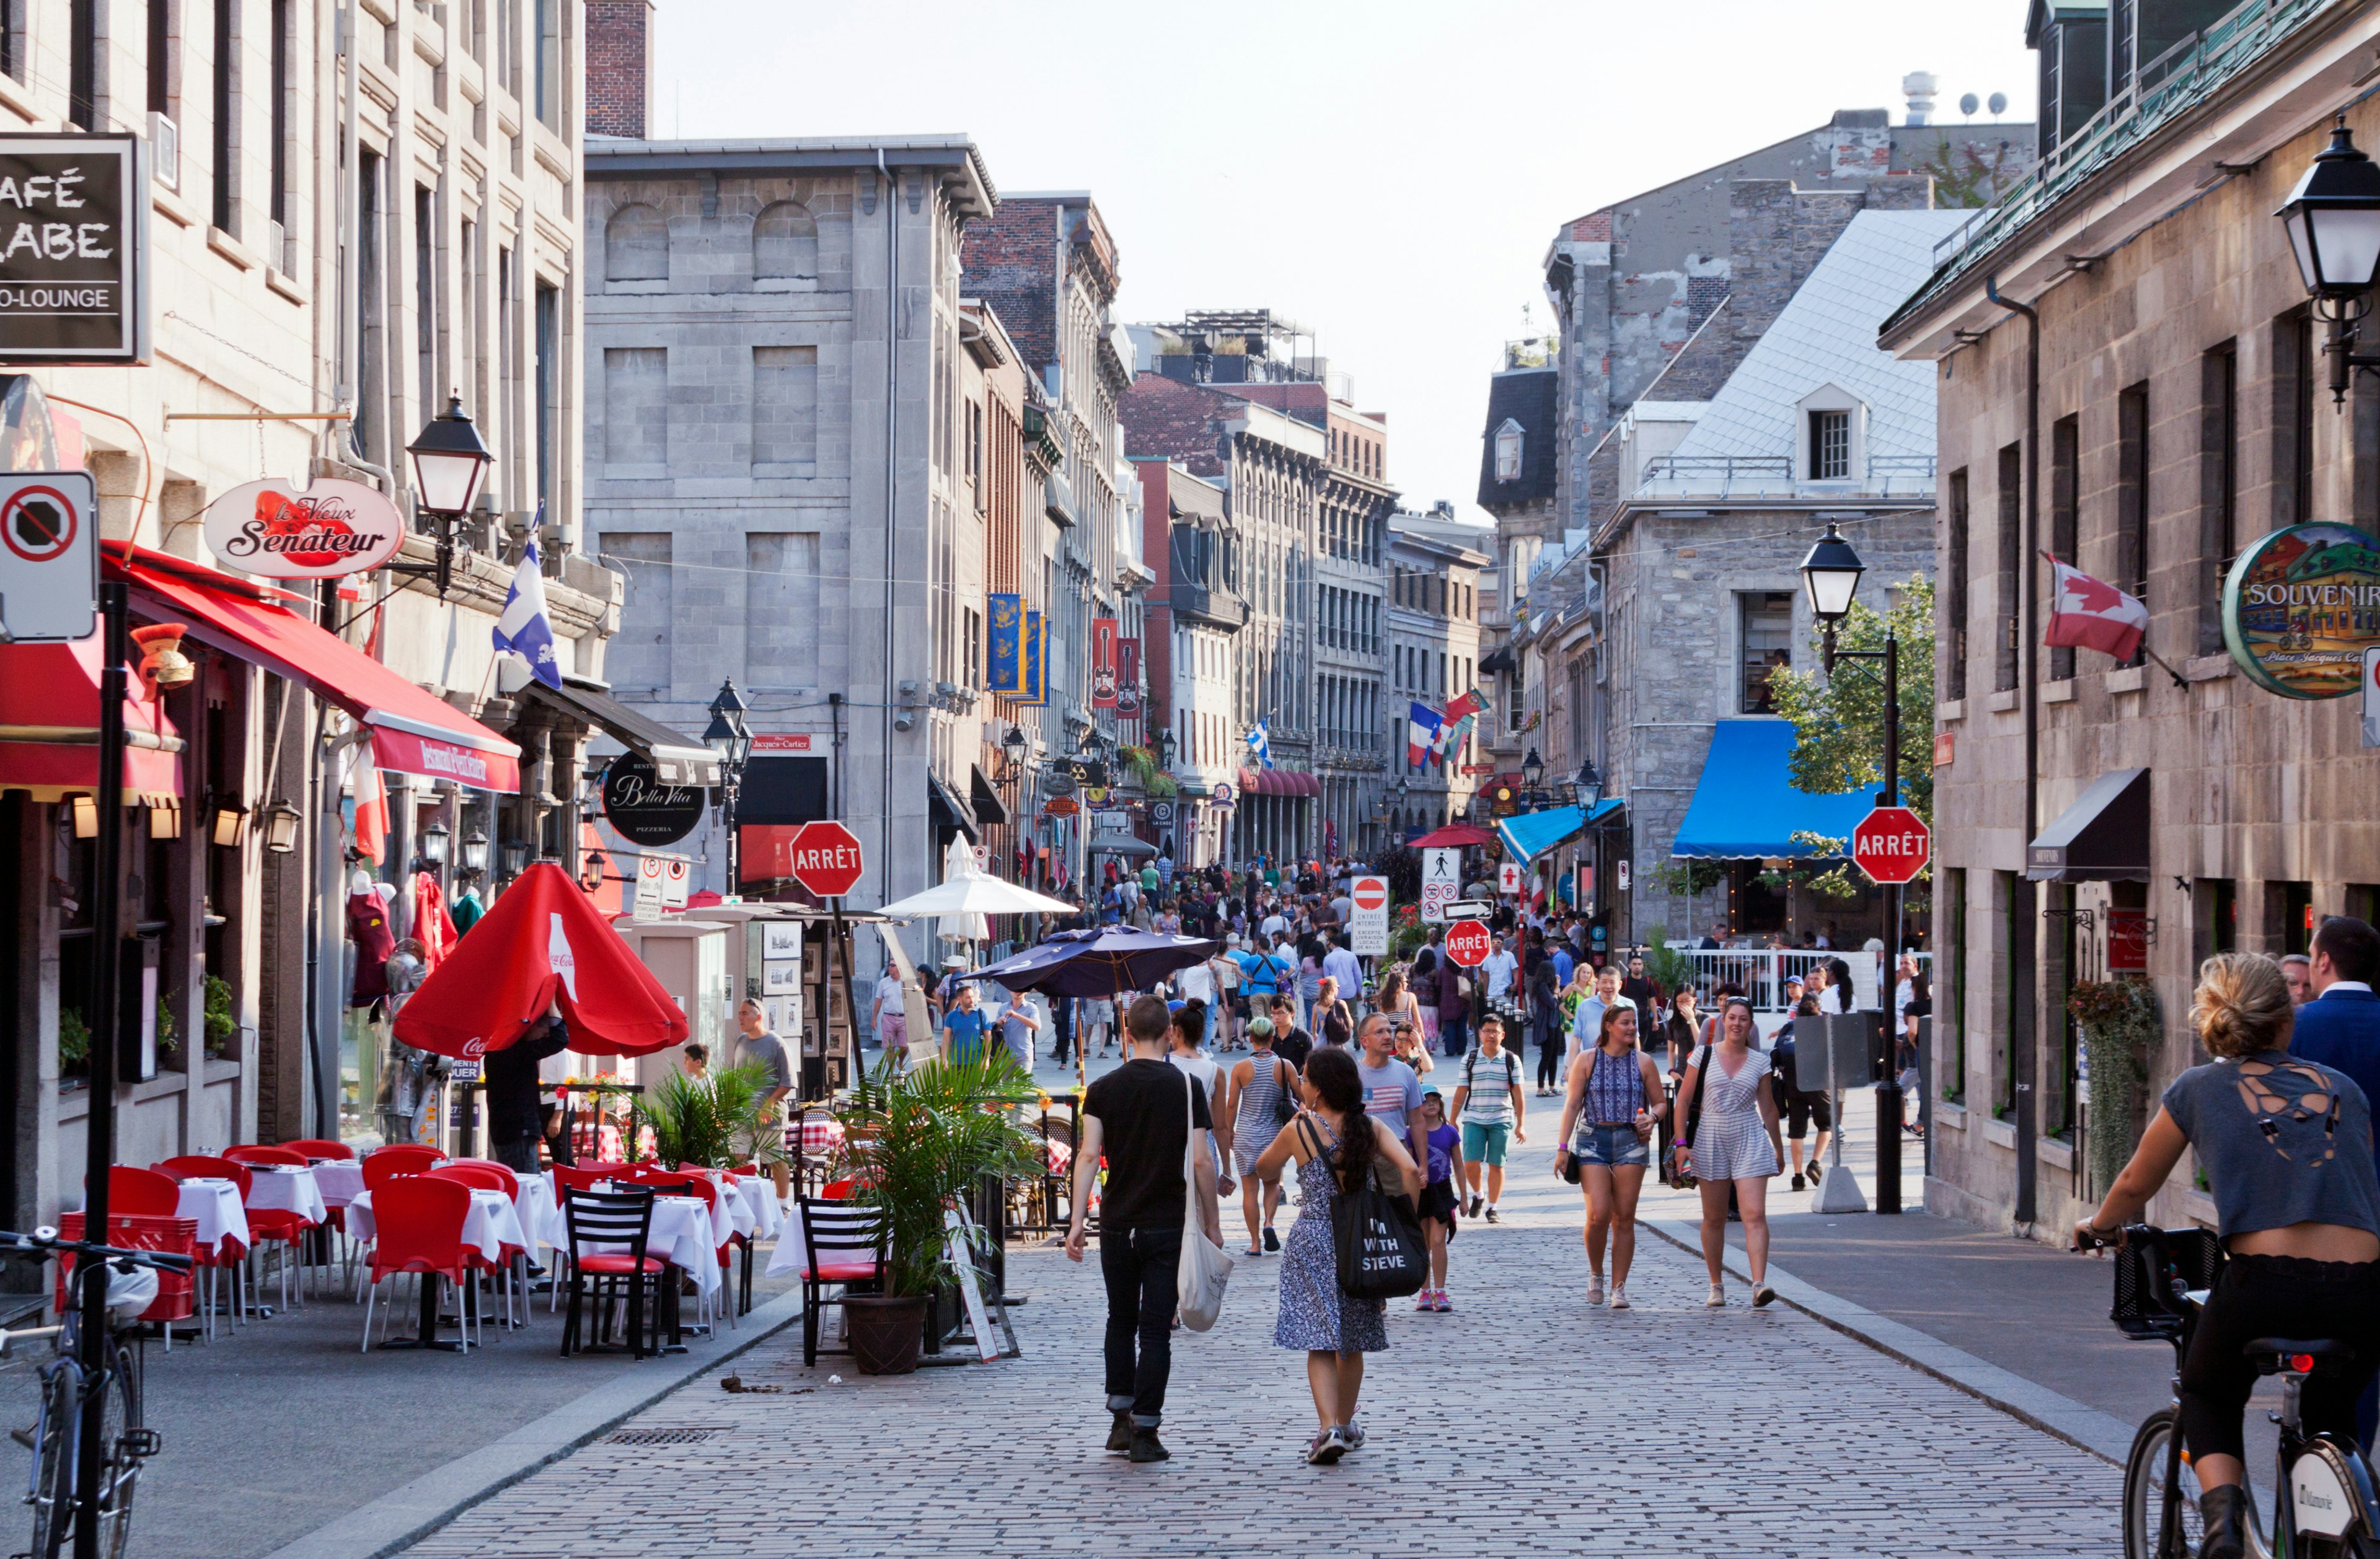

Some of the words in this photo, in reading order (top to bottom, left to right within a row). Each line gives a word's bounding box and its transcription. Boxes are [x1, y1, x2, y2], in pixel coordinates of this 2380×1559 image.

[0, 222, 113, 263] ABE
[275, 502, 290, 520] le
[297, 496, 356, 521] Vieux
[226, 520, 387, 556] Senateur
[2264, 651, 2296, 662] Place
[2300, 652, 2343, 665] Jacques
[753, 740, 807, 749] Jacques-Cartier
[610, 775, 664, 806] Bella
[664, 786, 691, 806] Vita
[1858, 831, 1926, 856] ARRÊT
[796, 845, 857, 869] ARRÊT
[1449, 934, 1489, 951] ARRÊT
[1362, 1255, 1406, 1270] STEVE
